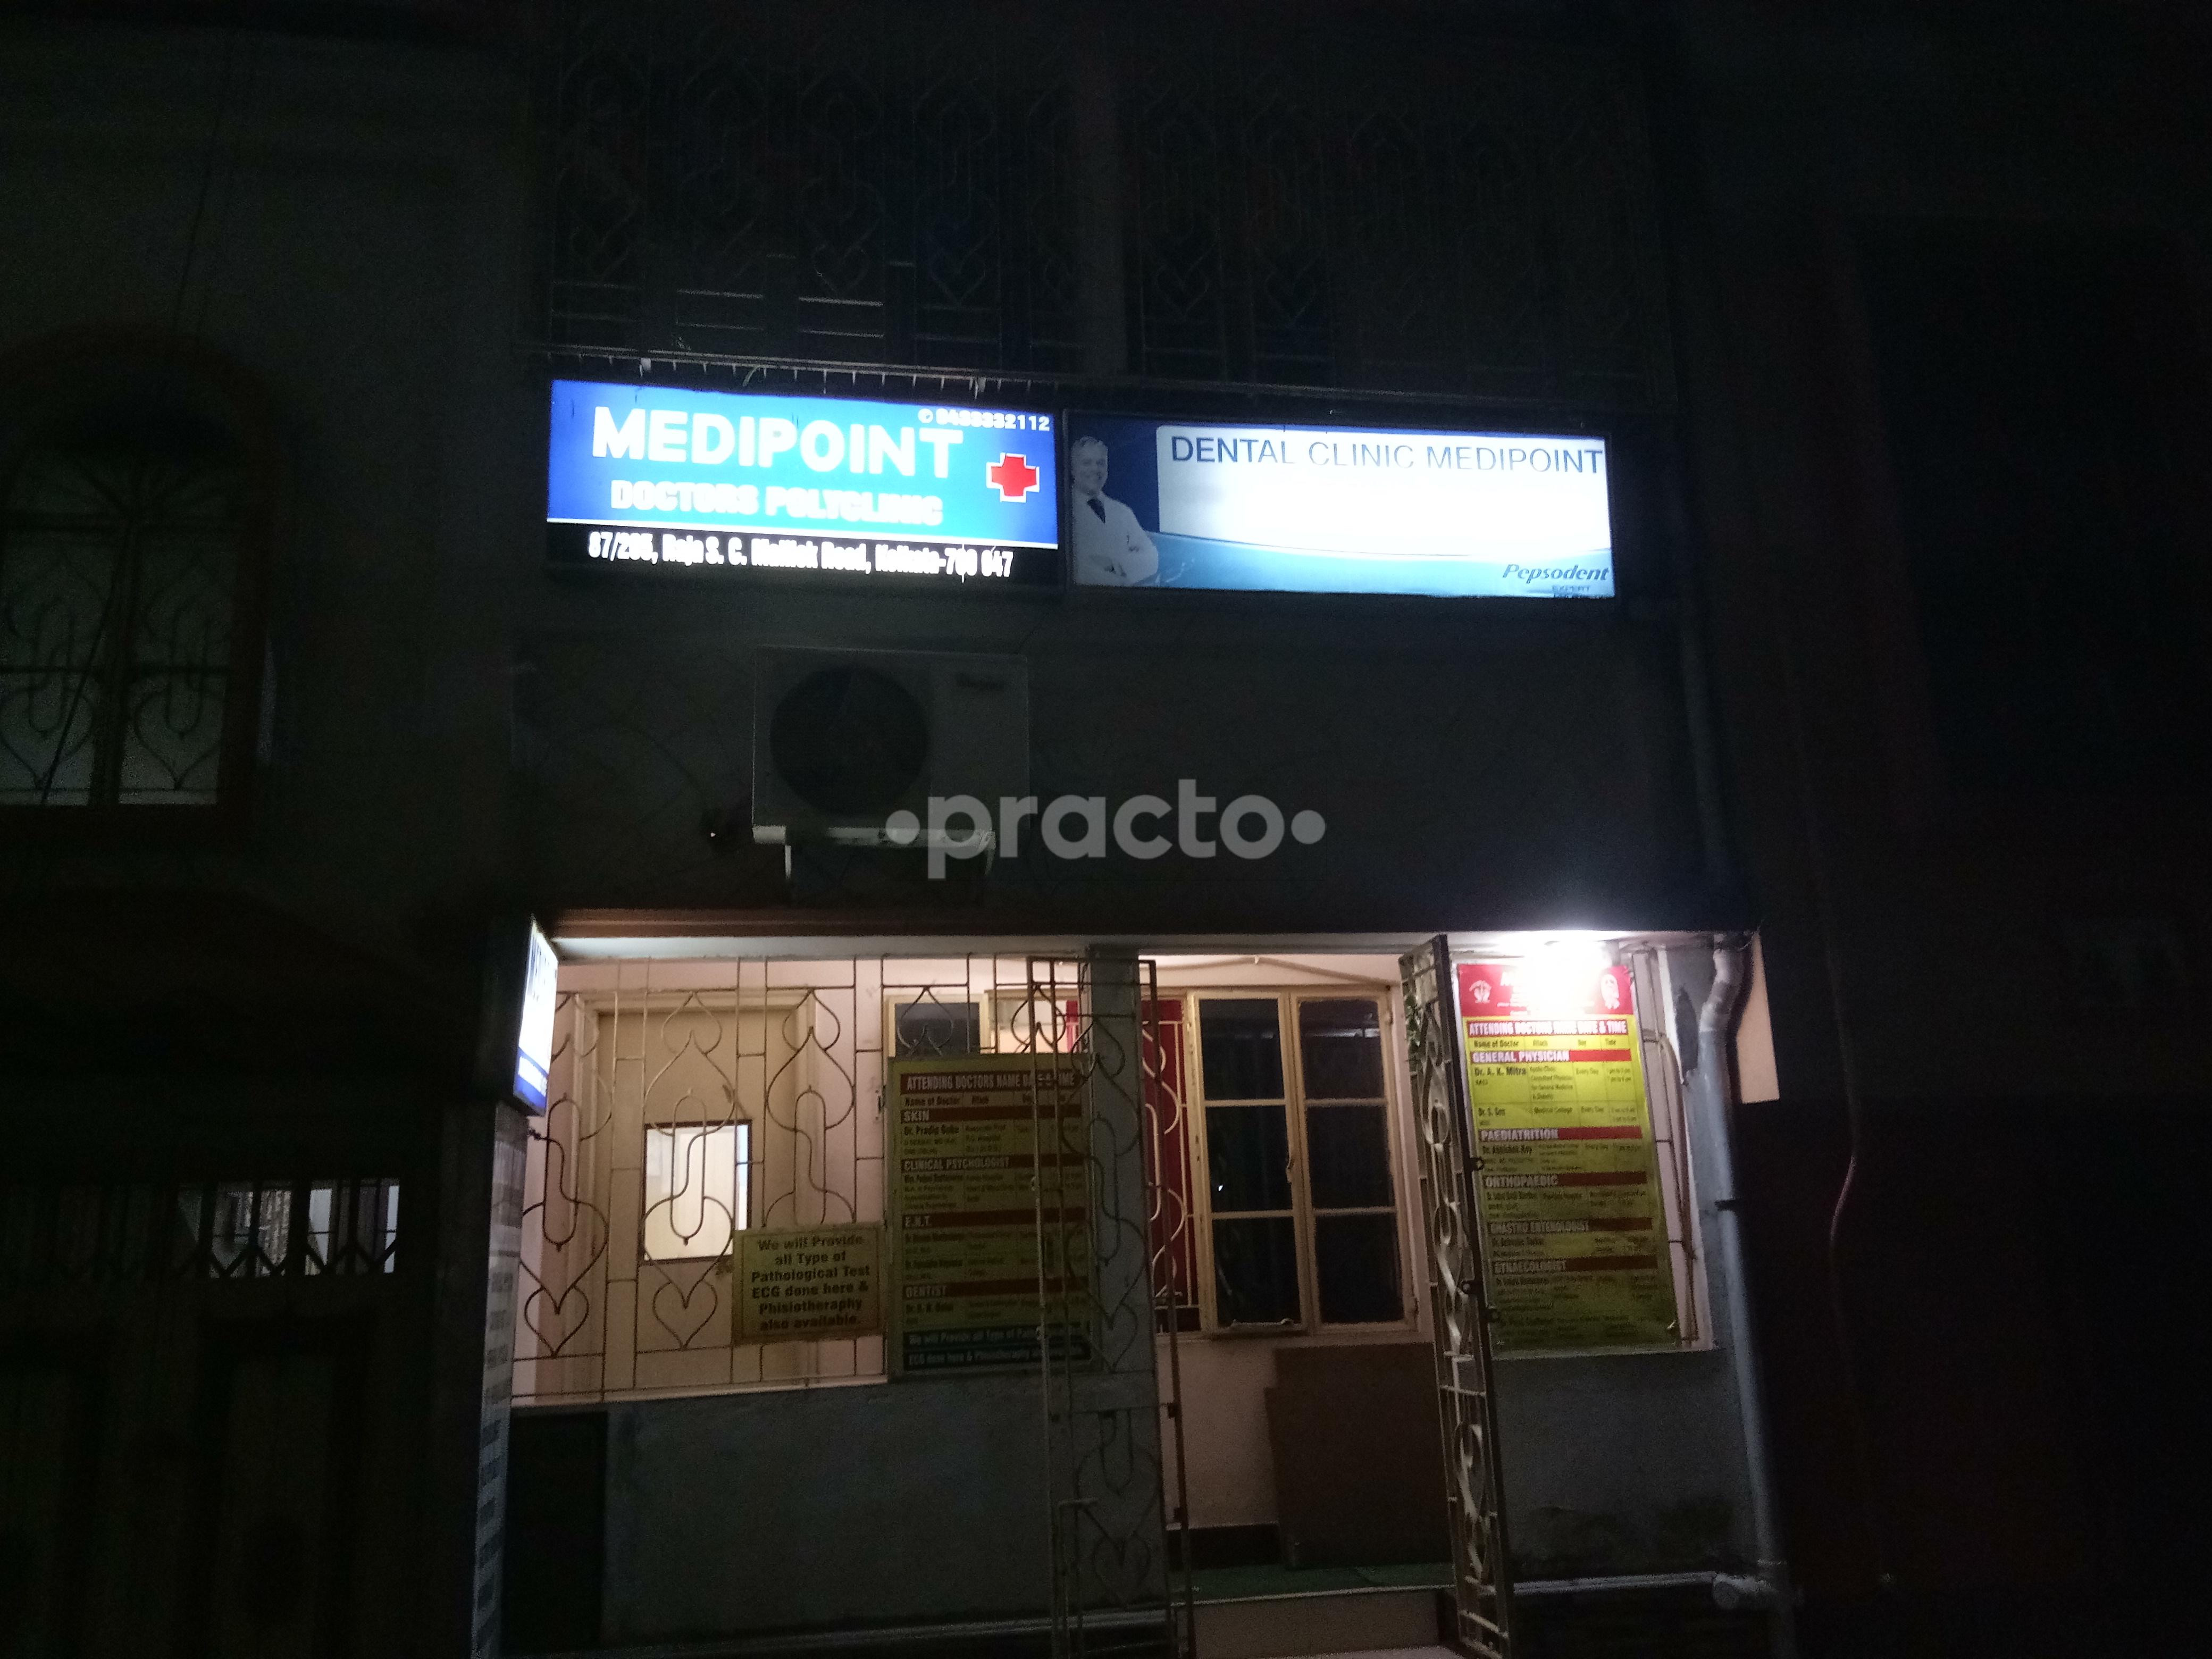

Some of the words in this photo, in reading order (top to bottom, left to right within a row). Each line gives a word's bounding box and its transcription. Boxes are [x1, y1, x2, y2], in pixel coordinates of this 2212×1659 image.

[593, 406, 963, 477] MEDIPOINT
[1171, 435, 1295, 464] DENTAL
[1308, 441, 1415, 469] CLINIC
[1427, 445, 1604, 474] MEDIPOINT
[611, 480, 757, 515] DOCTORS
[766, 484, 943, 525] POLYCLINIC
[1502, 564, 1610, 584] Pepsodent
[1469, 1022, 1514, 1035] ATTENDING
[1606, 1020, 1627, 1033] TIME
[1472, 1051, 1516, 1063] GENERAL
[1519, 1050, 1570, 1062] PHYSICIAN
[907, 1076, 953, 1090] ATTENDING
[955, 1075, 994, 1088] DOCTORS
[996, 1074, 1020, 1087] NAME
[903, 1110, 929, 1121] SKIN
[904, 1158, 944, 1171] CLINICAL
[946, 1157, 1009, 1170] PSYCHOLOGIST
[758, 1239, 779, 1251] We
[812, 1234, 865, 1246] Provide
[775, 1254, 792, 1265] all
[797, 1252, 828, 1266] Type
[833, 1251, 846, 1262] of
[751, 1267, 838, 1283] Pathological
[752, 1286, 781, 1299] ECG
[785, 1285, 818, 1297] done
[823, 1283, 853, 1294] here
